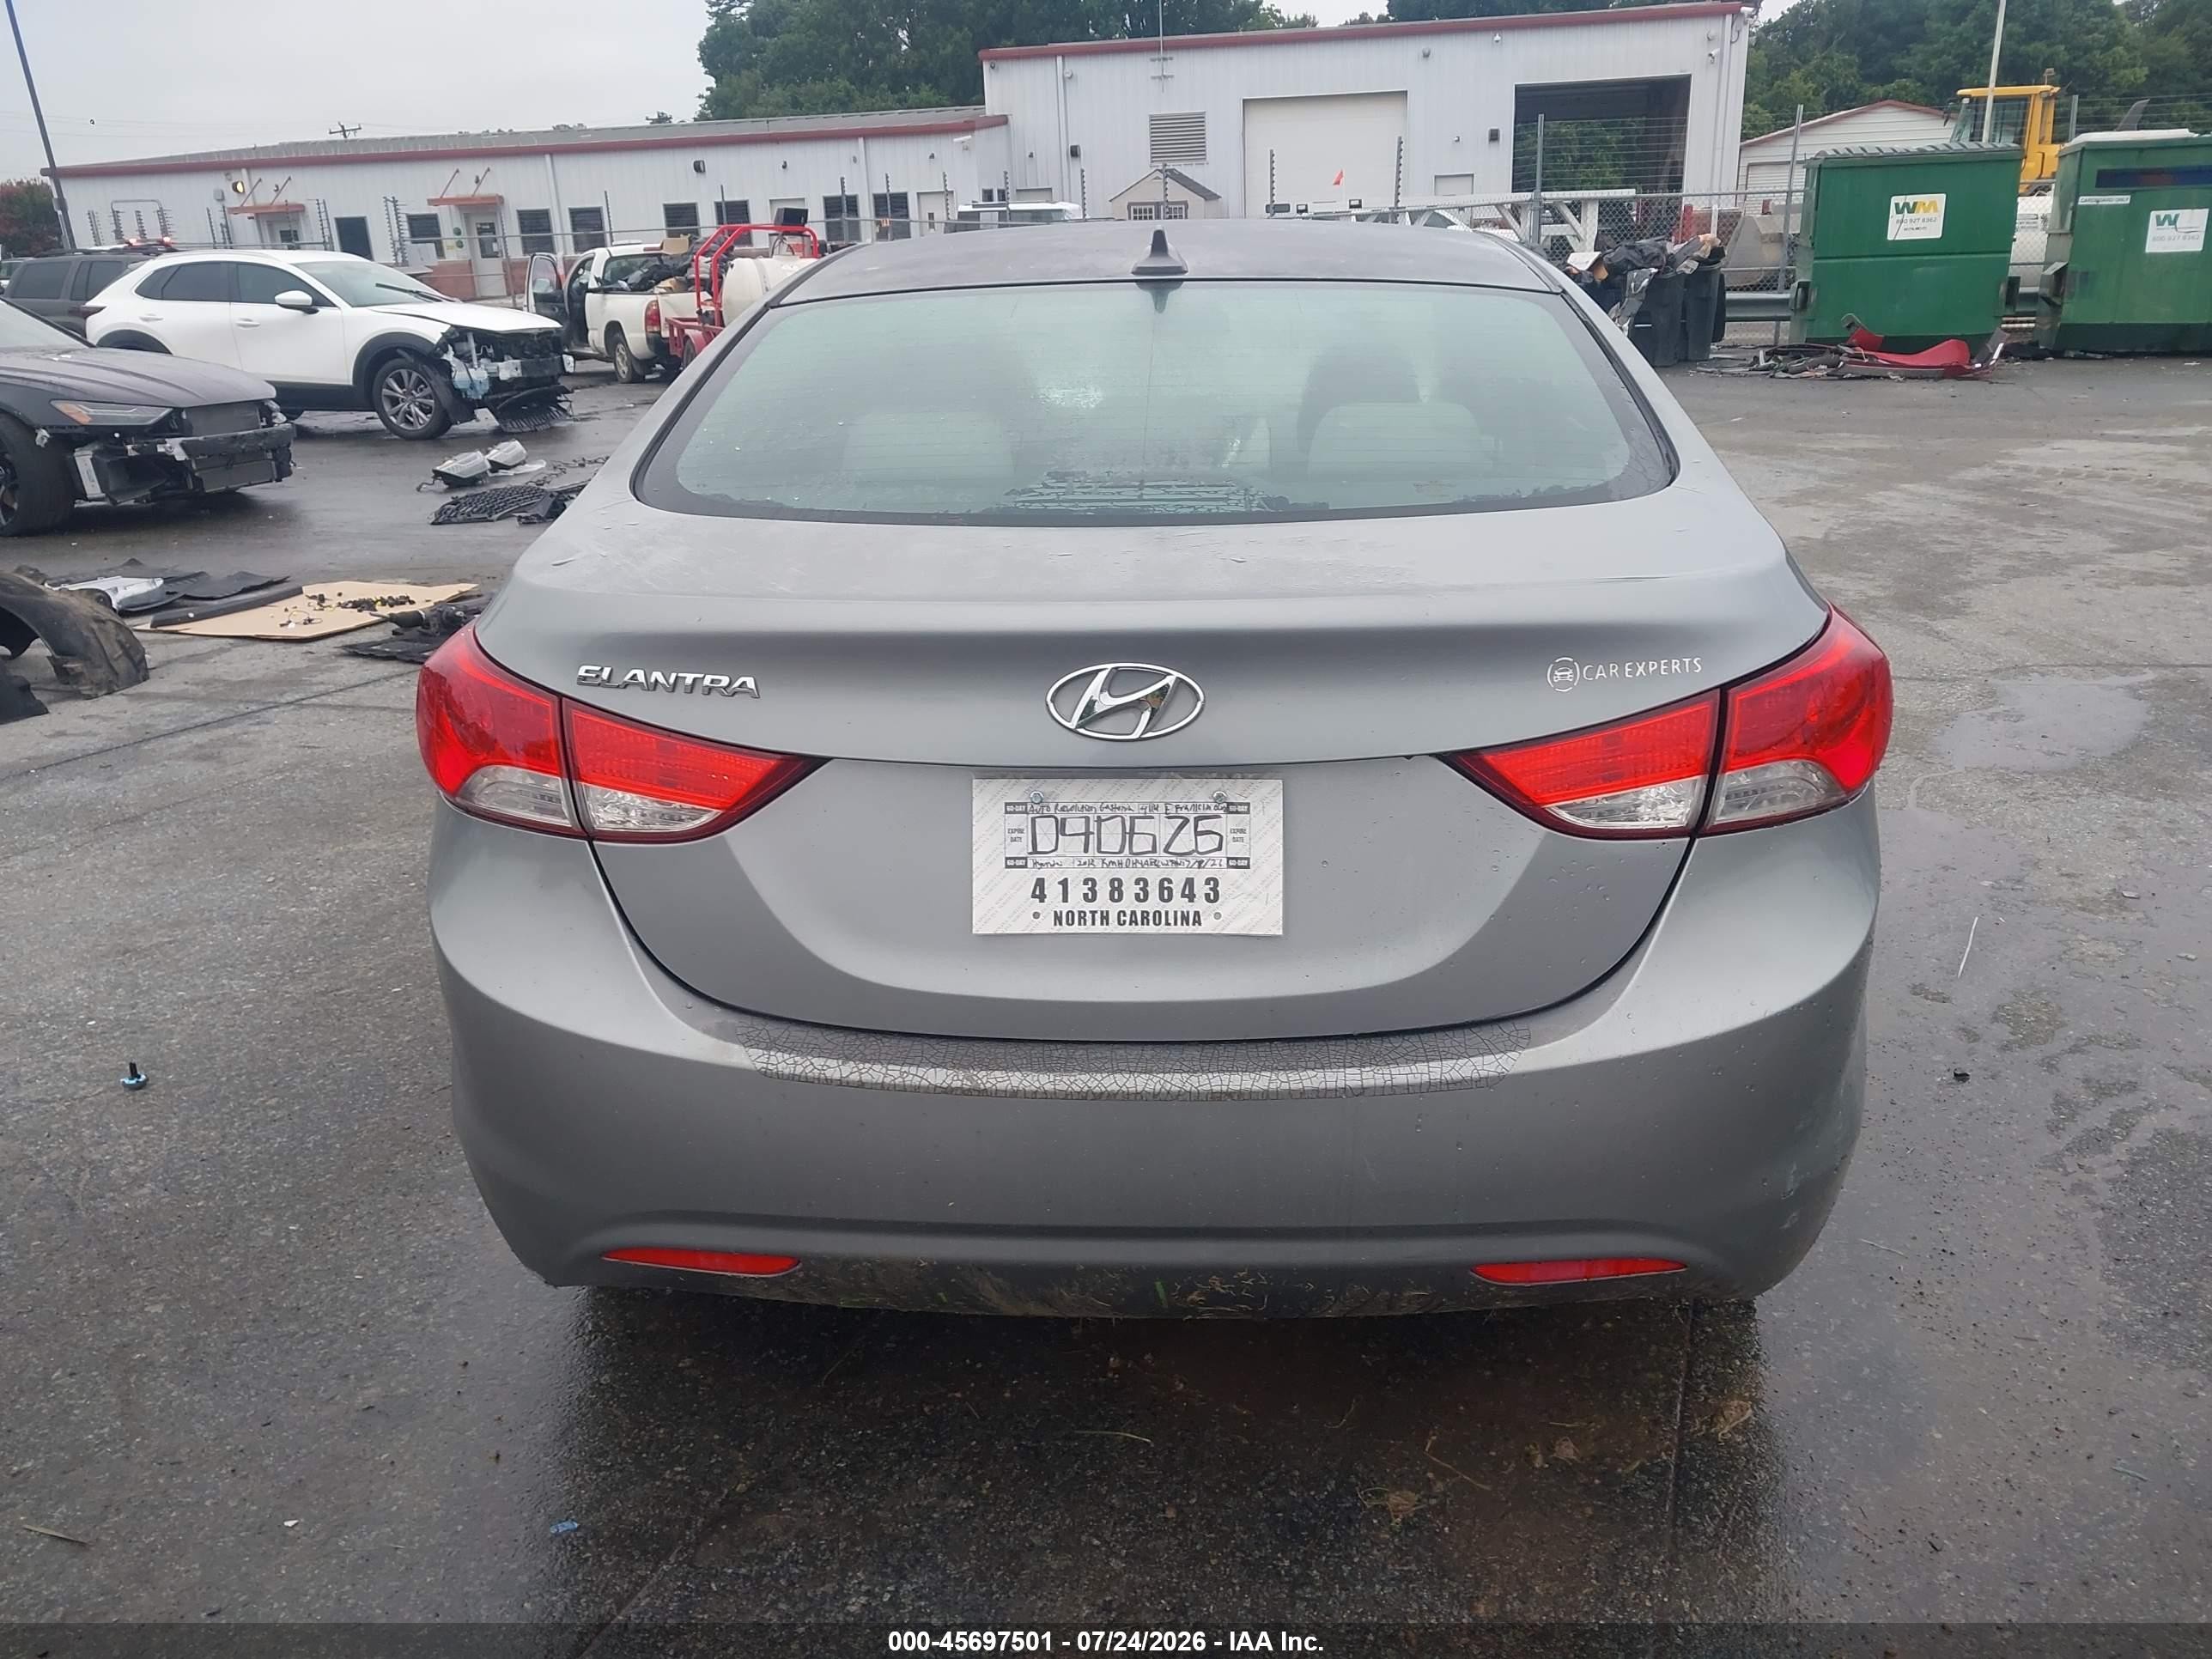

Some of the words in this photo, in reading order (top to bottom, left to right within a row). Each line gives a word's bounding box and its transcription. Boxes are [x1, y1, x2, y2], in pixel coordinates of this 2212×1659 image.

[1894, 199, 1938, 215] WM
[1583, 663, 1620, 681] CAR
[1624, 657, 1703, 678] EXPERTS
[576, 665, 761, 699] ELANTRA
[1030, 877, 1221, 903] 41383643
[1053, 910, 1109, 927] NORTH
[1117, 909, 1202, 927] CAROLINA
